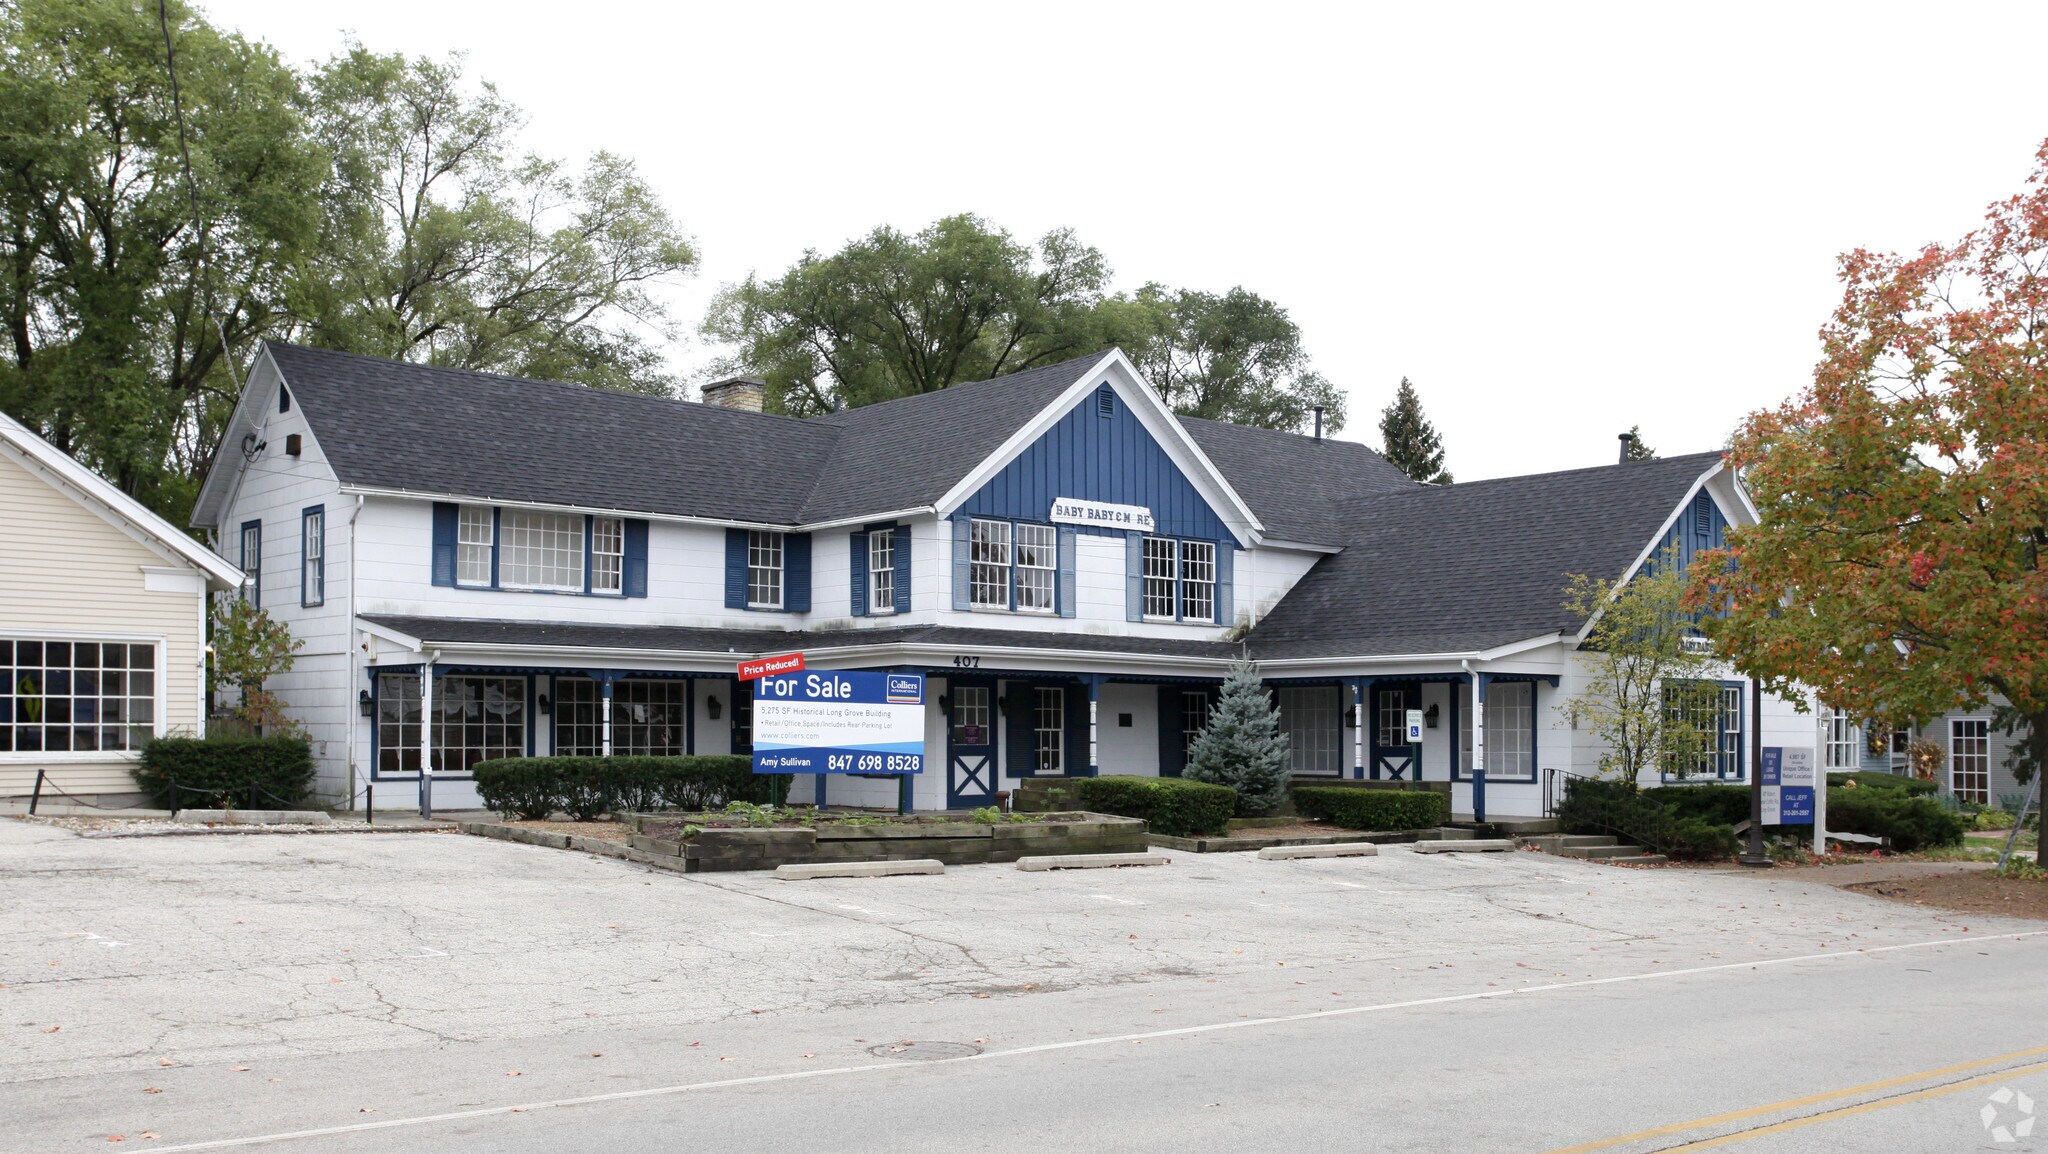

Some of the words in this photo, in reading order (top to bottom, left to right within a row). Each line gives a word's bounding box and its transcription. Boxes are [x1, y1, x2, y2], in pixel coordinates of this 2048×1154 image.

[1056, 505, 1084, 517] BABY
[1087, 508, 1114, 520] BABY
[744, 665, 764, 675] Price
[765, 657, 799, 671] Reduced!
[953, 655, 980, 668] 407
[760, 675, 798, 697] For
[806, 674, 852, 699] Sale
[890, 680, 917, 689] Colliers
[761, 706, 780, 715] 5,275
[782, 706, 791, 714] SF
[793, 708, 825, 716] Historical
[826, 708, 843, 718] Long
[844, 709, 864, 717] Grove
[865, 709, 892, 718] Building
[761, 732, 820, 740] www.colliers.com
[760, 758, 778, 768] Amy
[780, 757, 811, 767] Sullivan
[828, 755, 853, 770] 847
[858, 755, 882, 770] 698
[887, 755, 920, 770] 8528
